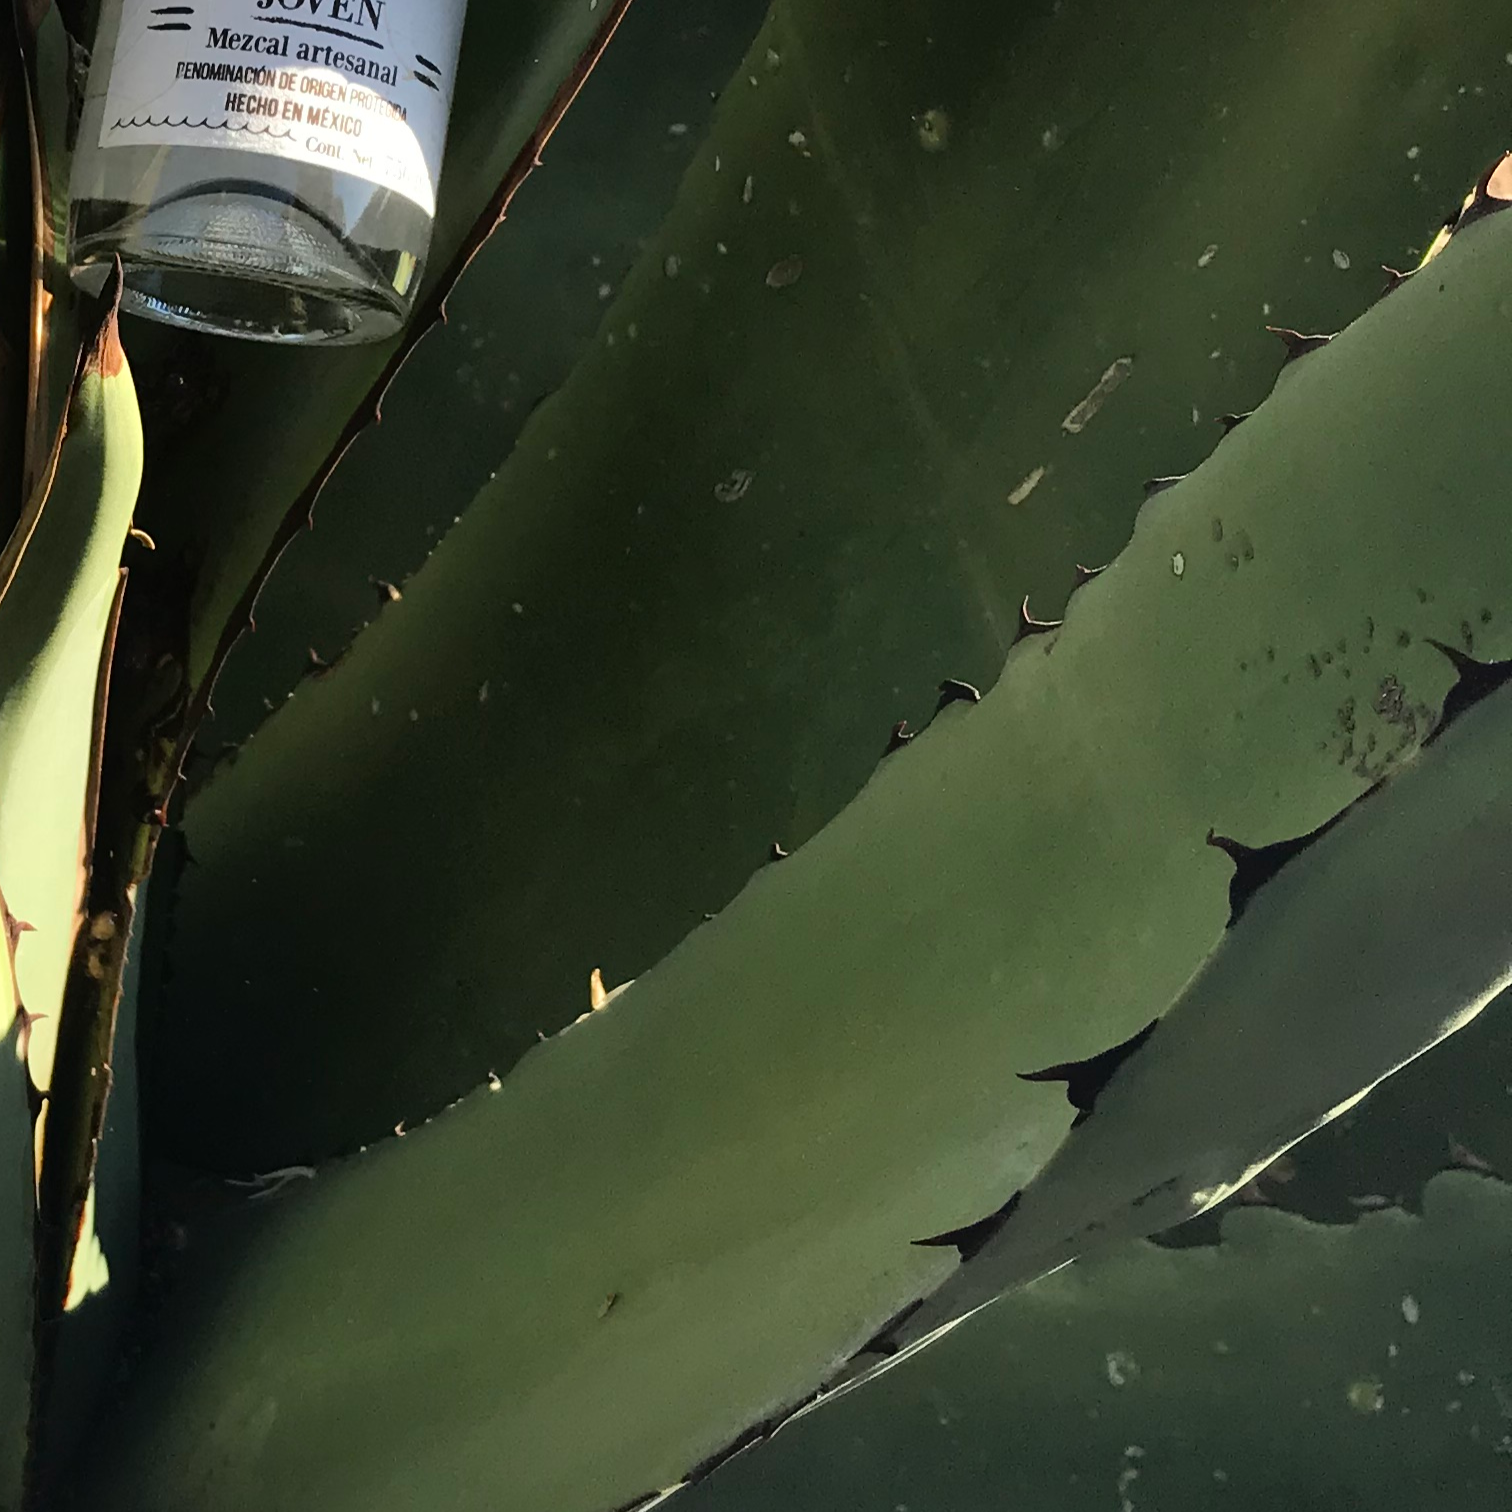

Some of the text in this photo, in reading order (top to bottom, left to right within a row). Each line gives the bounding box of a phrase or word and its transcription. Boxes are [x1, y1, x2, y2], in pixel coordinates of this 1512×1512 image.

[205, 27, 398, 87] Mezcal artesanal
[175, 62, 407, 122] DENOMINACIÓN DE ORIGEN PROTEGIDA
[224, 92, 363, 138] HECHO EN MÉXICO
